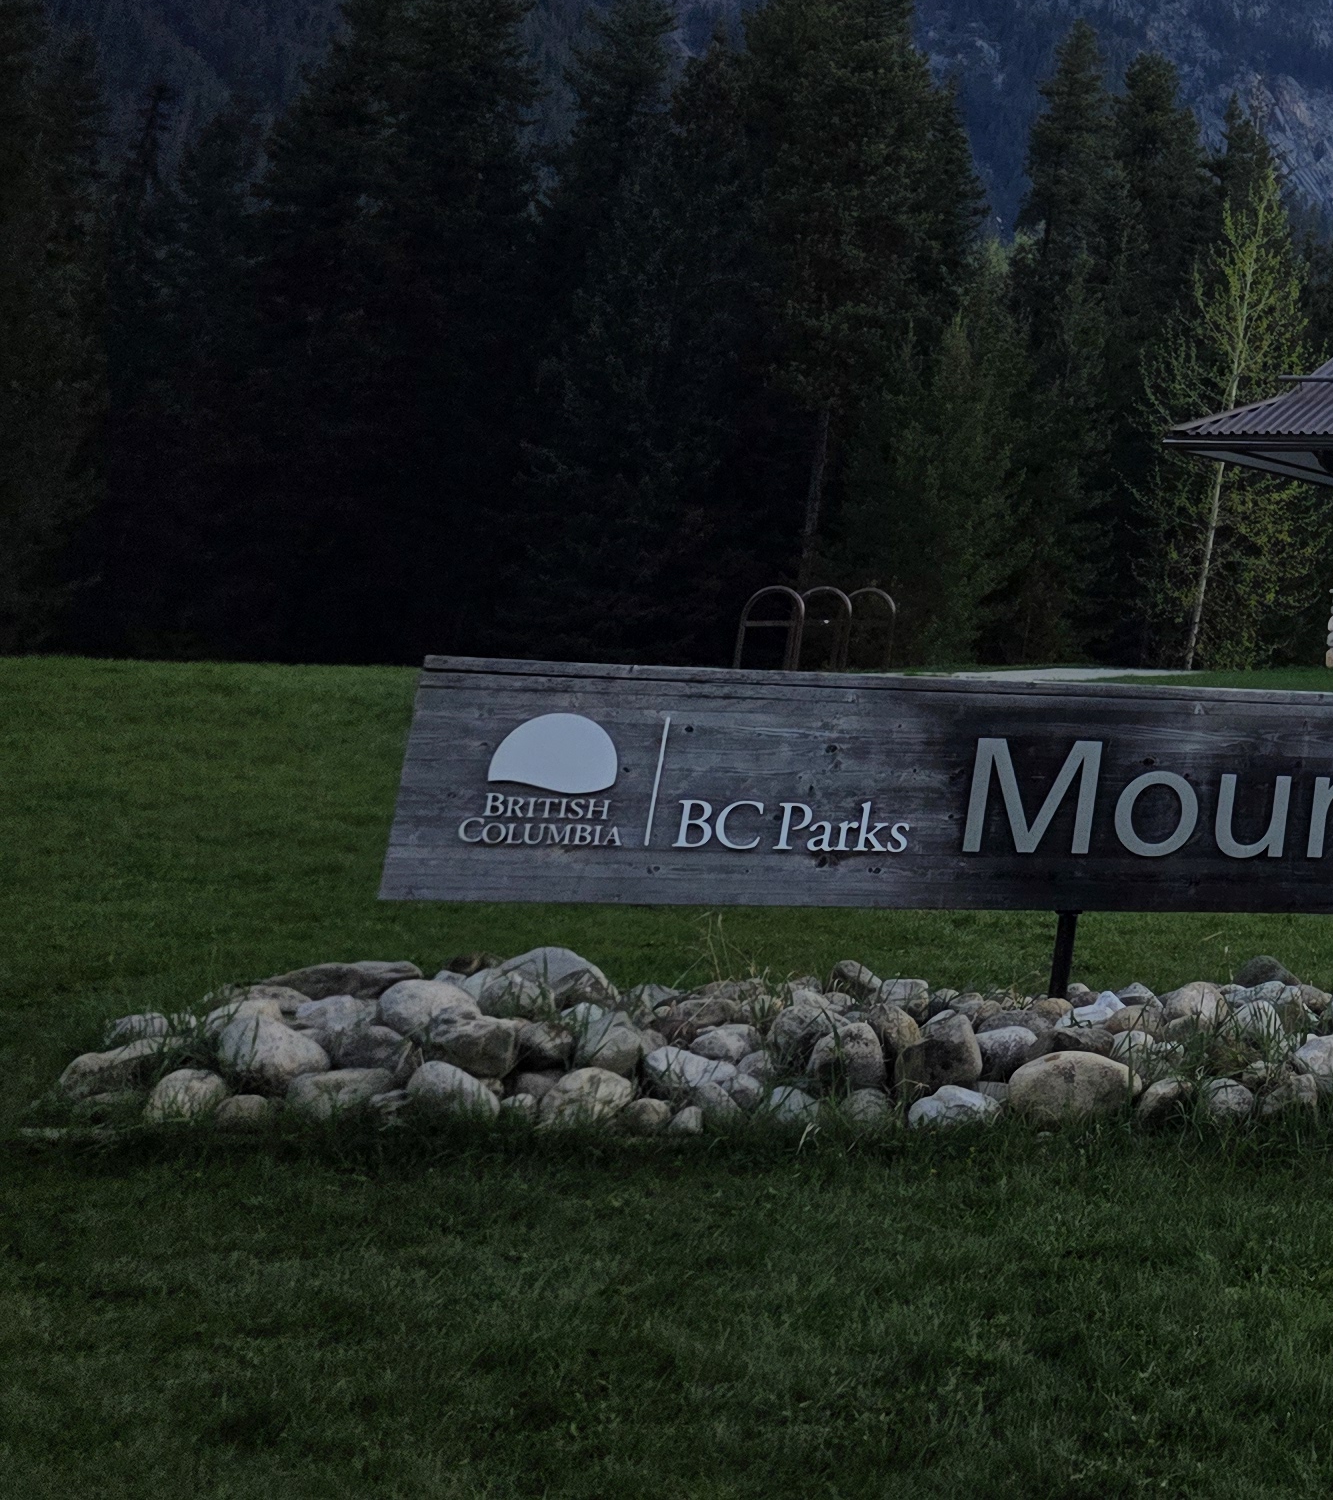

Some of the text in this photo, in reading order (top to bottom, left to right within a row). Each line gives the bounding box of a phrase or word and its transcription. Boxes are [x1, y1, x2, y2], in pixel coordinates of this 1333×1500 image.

[481, 792, 611, 820] BRITISH
[457, 817, 622, 846] COLUMBIA
[671, 799, 910, 853] BC Parks
